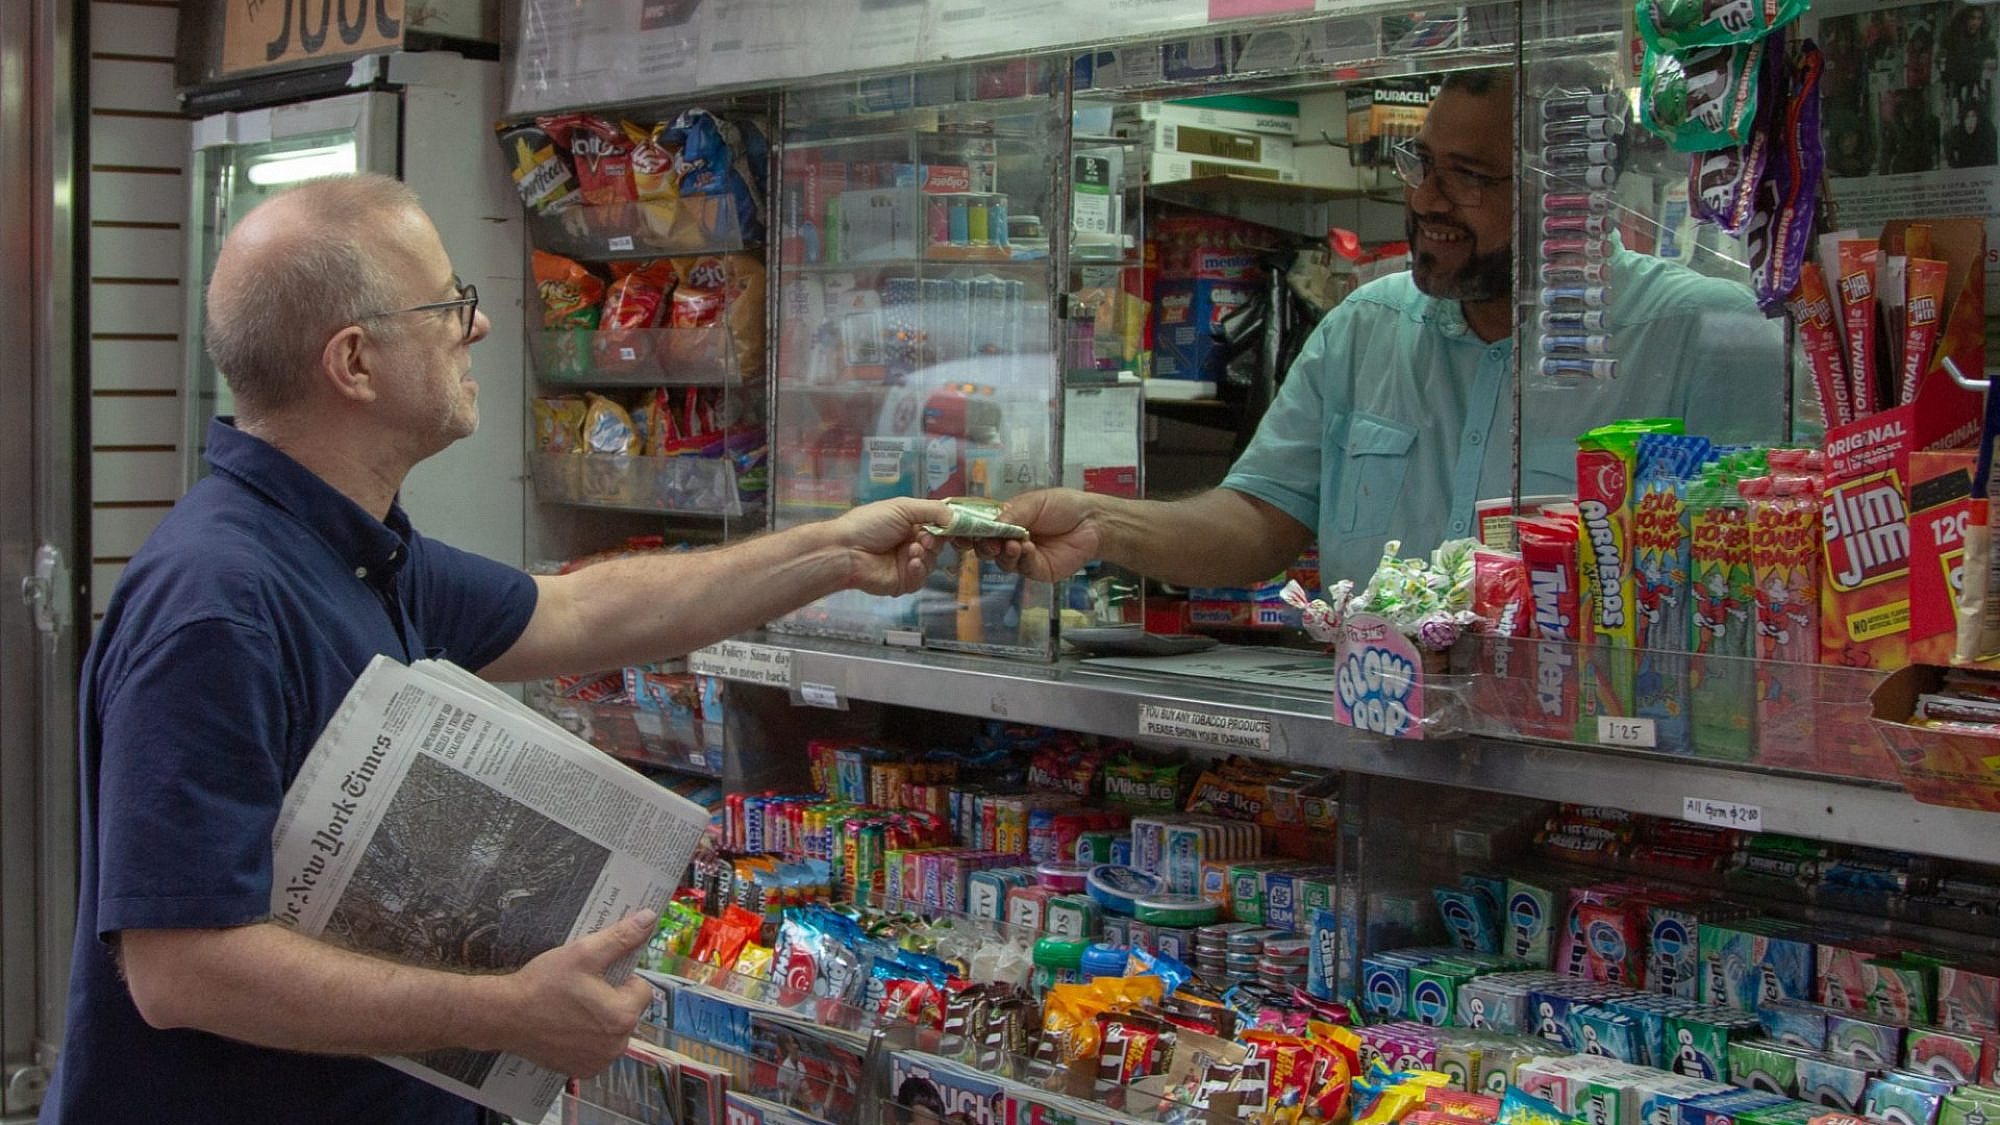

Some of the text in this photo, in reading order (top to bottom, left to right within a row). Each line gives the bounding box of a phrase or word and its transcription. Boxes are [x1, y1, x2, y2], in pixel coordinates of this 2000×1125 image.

[1375, 89, 1429, 103] DURACELL
[1852, 328, 1869, 411] ORIGINAL
[1827, 420, 1907, 459] ORIGINAL
[1823, 485, 1905, 542] slim
[1839, 522, 1909, 587] jim
[1852, 618, 1869, 636] NO
[750, 648, 772, 663] Same
[774, 651, 791, 668] day
[739, 668, 765, 682] money
[1338, 647, 1415, 709] BLOW
[1160, 708, 1175, 720] BUY
[1174, 709, 1191, 722] ANY
[1191, 712, 1227, 728] TOBACCO
[1227, 717, 1272, 733] PRODUCTS
[1148, 722, 1176, 735] PLEASE
[1175, 726, 1198, 739] SHOW
[1198, 729, 1219, 741] YOUR
[1104, 776, 1147, 796] Mike
[1200, 782, 1262, 813] Mike Ike
[1687, 799, 1702, 815] All
[274, 733, 393, 931] he New York Times
[602, 884, 621, 907] Lost
[1271, 896, 1290, 906] tac
[1274, 888, 1288, 898] tic
[1237, 901, 1259, 916] GUM
[1271, 909, 1293, 923] GUM
